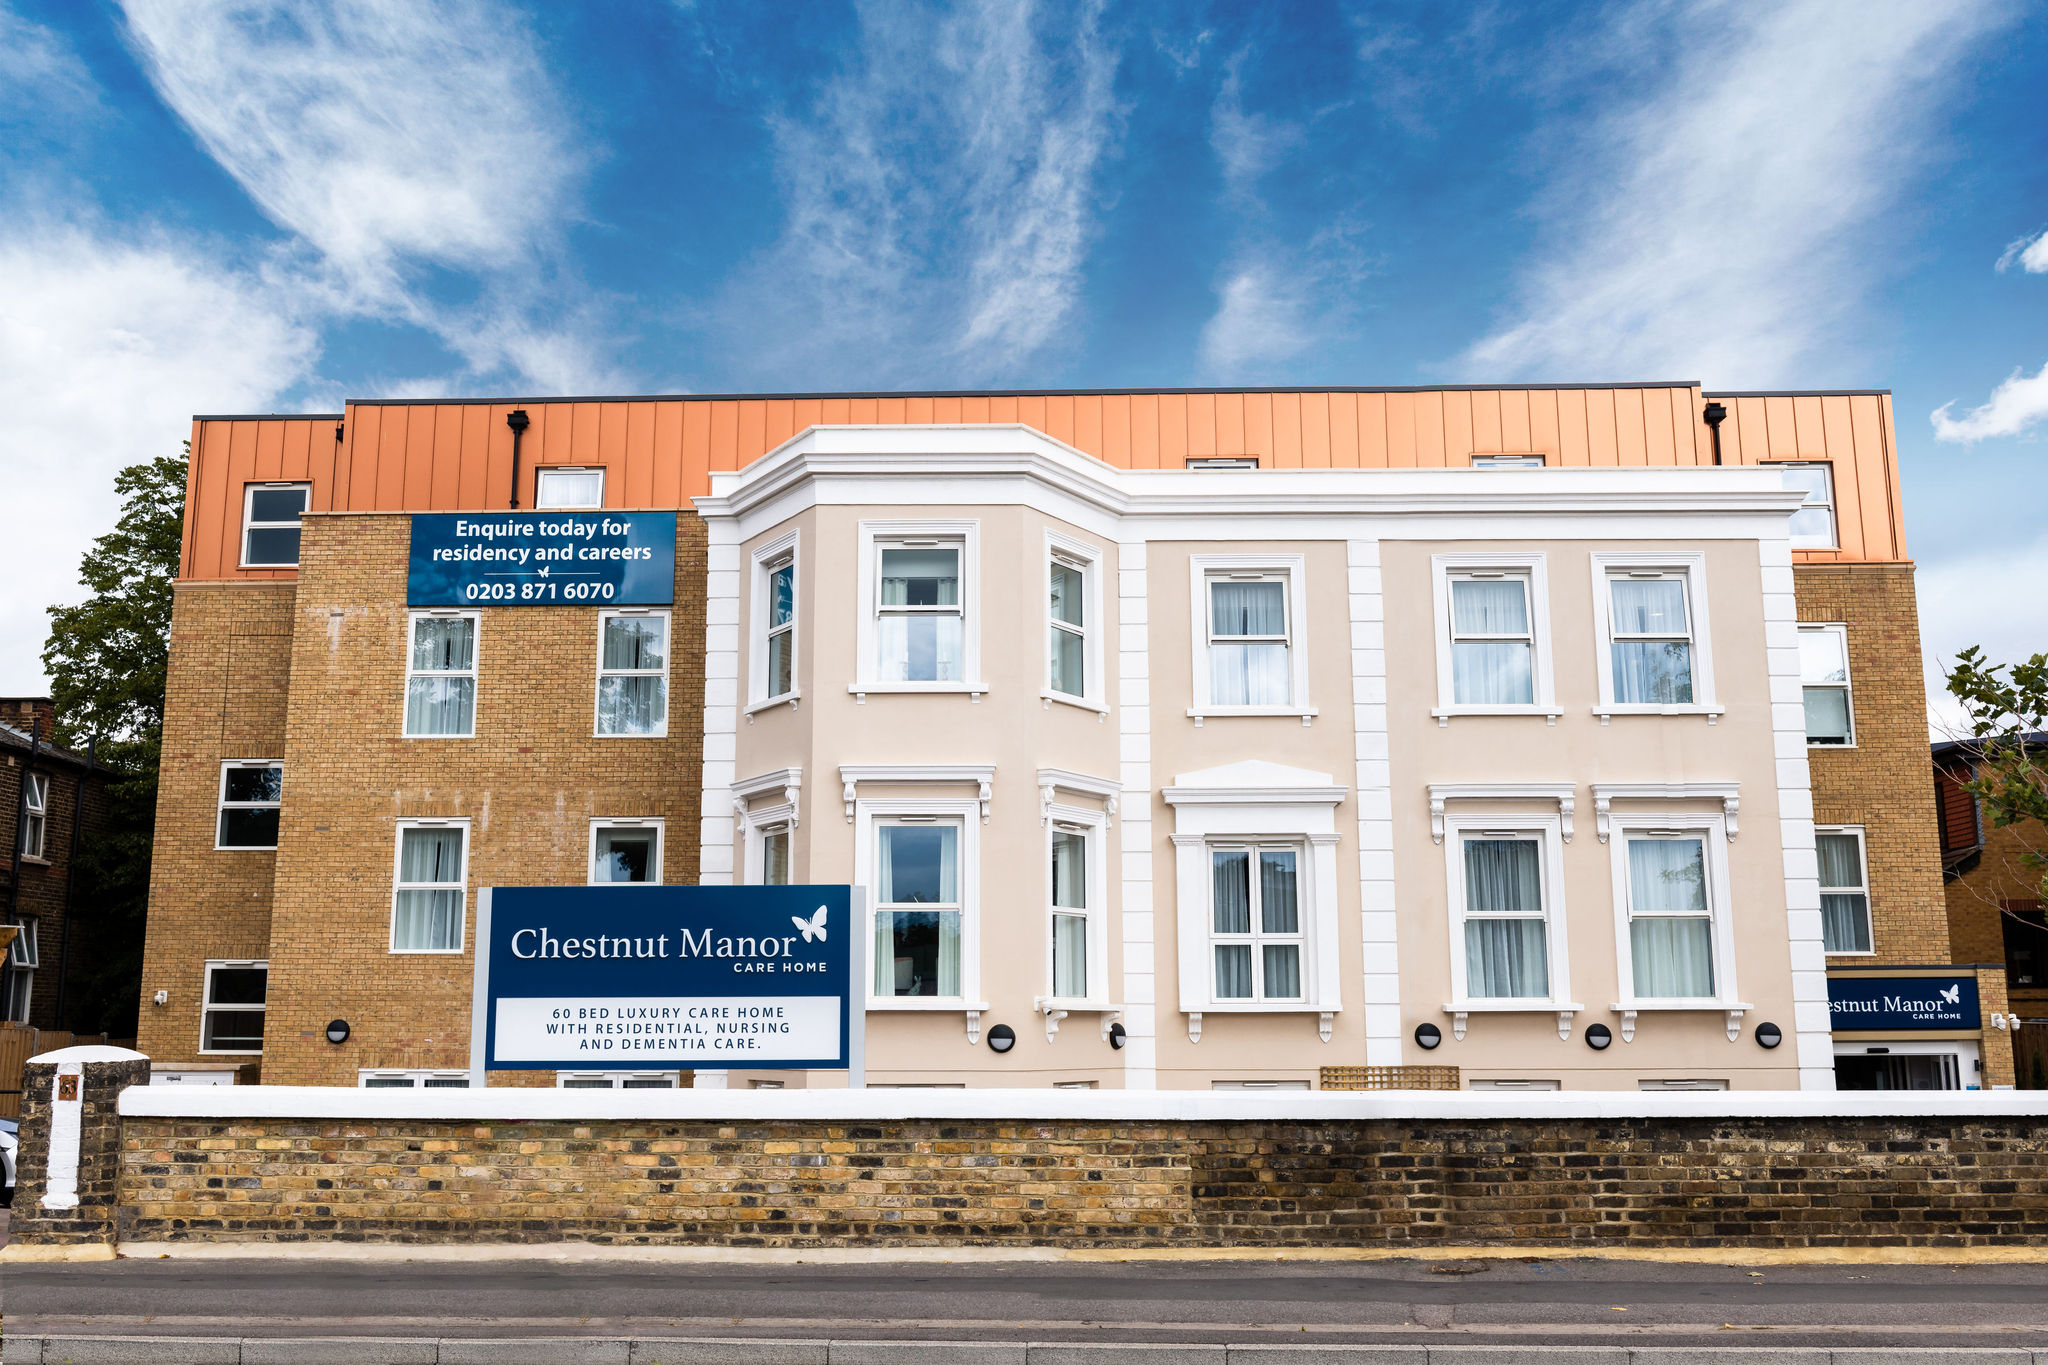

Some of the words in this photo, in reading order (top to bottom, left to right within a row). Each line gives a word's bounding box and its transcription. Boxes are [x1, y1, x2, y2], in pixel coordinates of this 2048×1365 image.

[456, 519, 534, 541] Enquire
[538, 518, 598, 540] today
[601, 518, 632, 536] for
[432, 543, 531, 566] residency
[534, 543, 574, 561] and
[578, 545, 652, 561] careers
[465, 583, 516, 600] 0203
[520, 583, 557, 600] 871
[563, 582, 615, 599] 6070
[511, 927, 669, 959] Chestnut
[679, 928, 797, 958] Manor
[733, 962, 775, 973] CARE
[783, 962, 827, 973] HOME
[1883, 995, 1944, 1013] Manor
[552, 1007, 571, 1019] 60
[579, 1007, 609, 1019] BED
[617, 1007, 681, 1019] LUXURY
[688, 1007, 729, 1018] CARE
[737, 1007, 784, 1018] HOME
[1912, 1012, 1935, 1020] CARE
[1937, 1012, 1961, 1020] HOME
[546, 1023, 587, 1035] WITH
[595, 1022, 708, 1036] RESIDENTIAL,
[716, 1022, 790, 1034] NURSING
[579, 1038, 613, 1050] AND
[621, 1038, 706, 1050] DEMENTIA
[714, 1038, 761, 1050] CARE.
